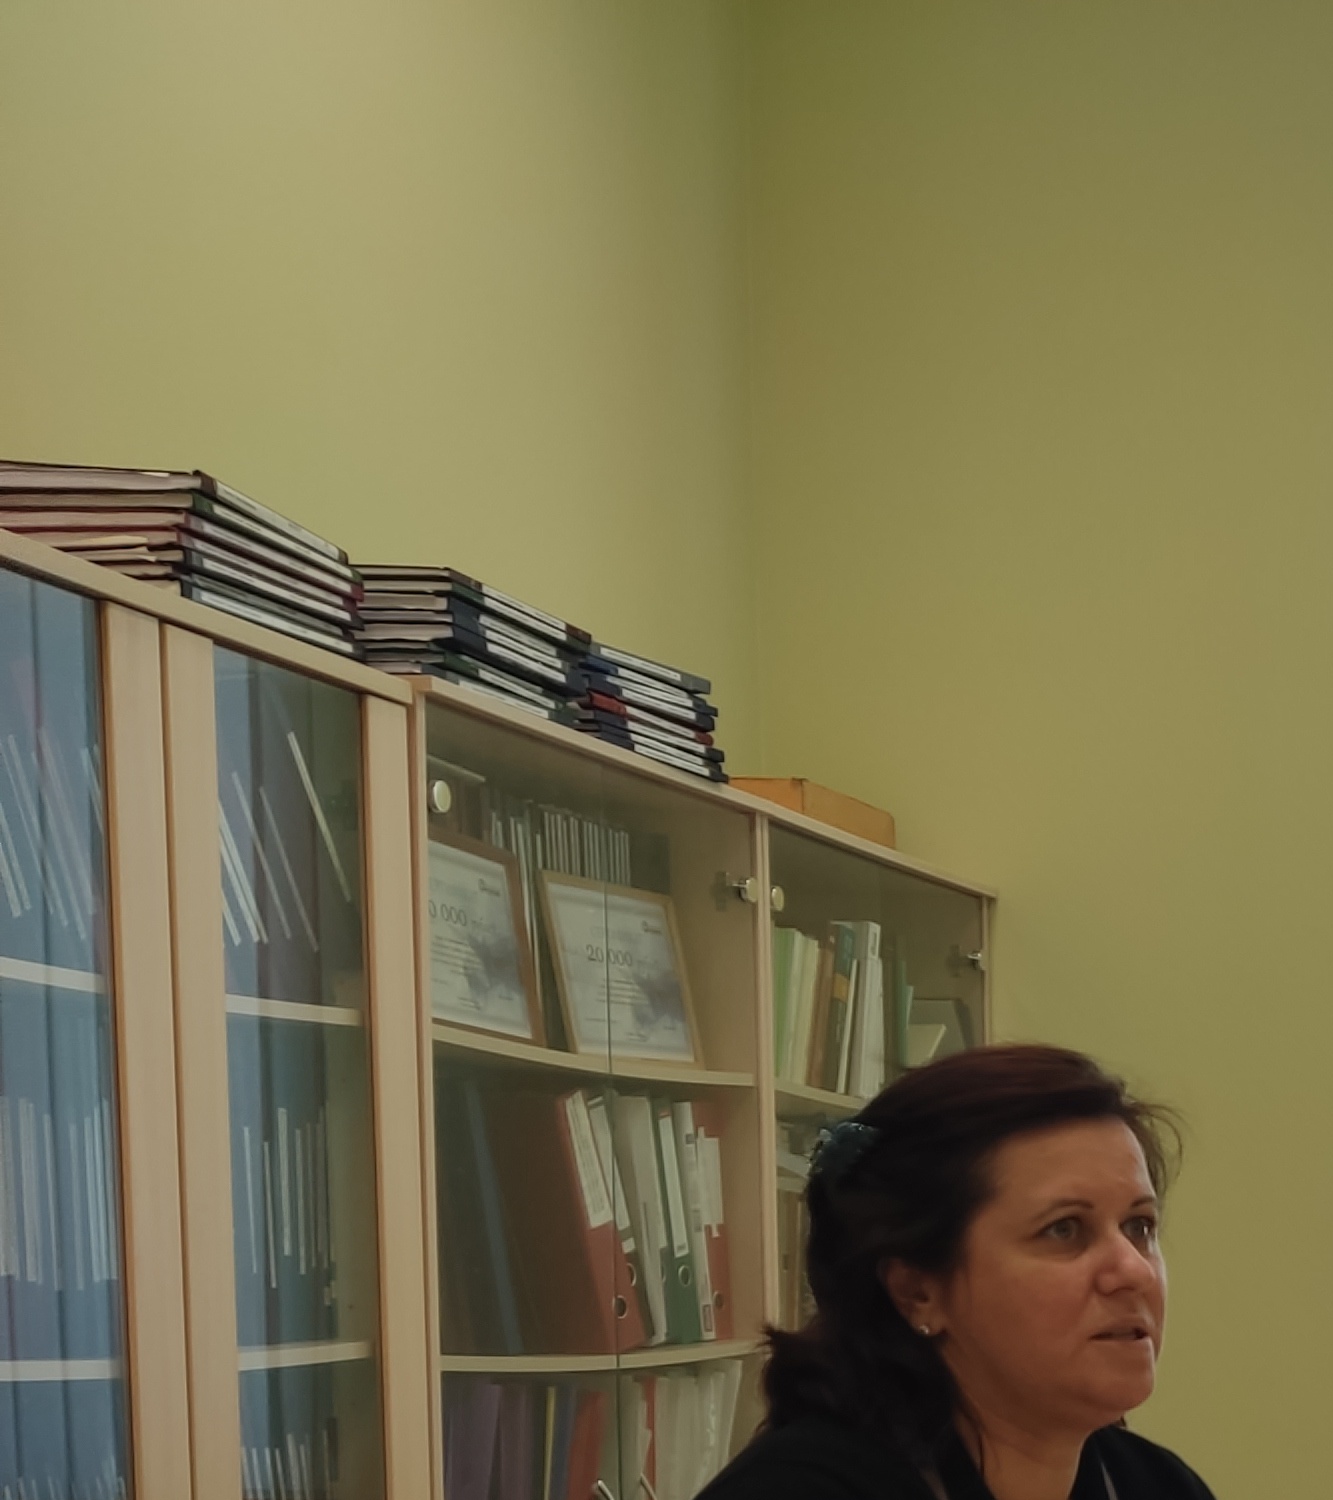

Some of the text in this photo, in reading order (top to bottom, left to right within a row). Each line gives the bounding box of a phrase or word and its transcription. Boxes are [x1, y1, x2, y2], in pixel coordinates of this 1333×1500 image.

[441, 903, 467, 926] 000
[586, 944, 604, 963] 20
[607, 948, 632, 967] 000
